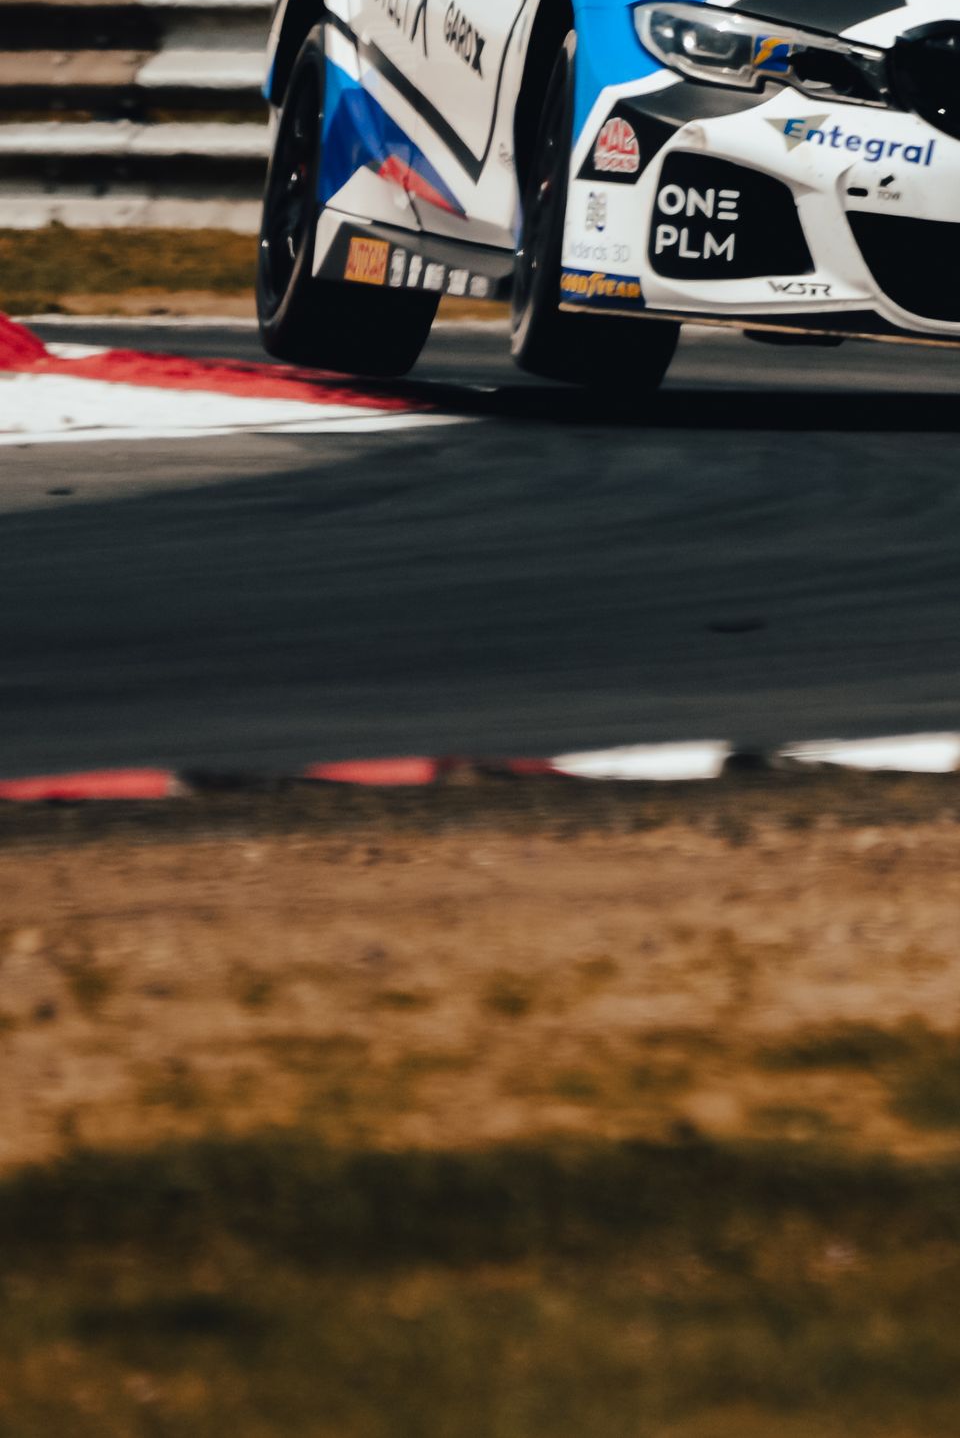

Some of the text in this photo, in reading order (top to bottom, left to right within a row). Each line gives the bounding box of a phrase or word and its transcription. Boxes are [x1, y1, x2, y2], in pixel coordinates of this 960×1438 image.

[783, 118, 936, 167] Entegral
[657, 183, 741, 221] ONE
[654, 223, 736, 262] PLM
[767, 280, 832, 298] WSR
